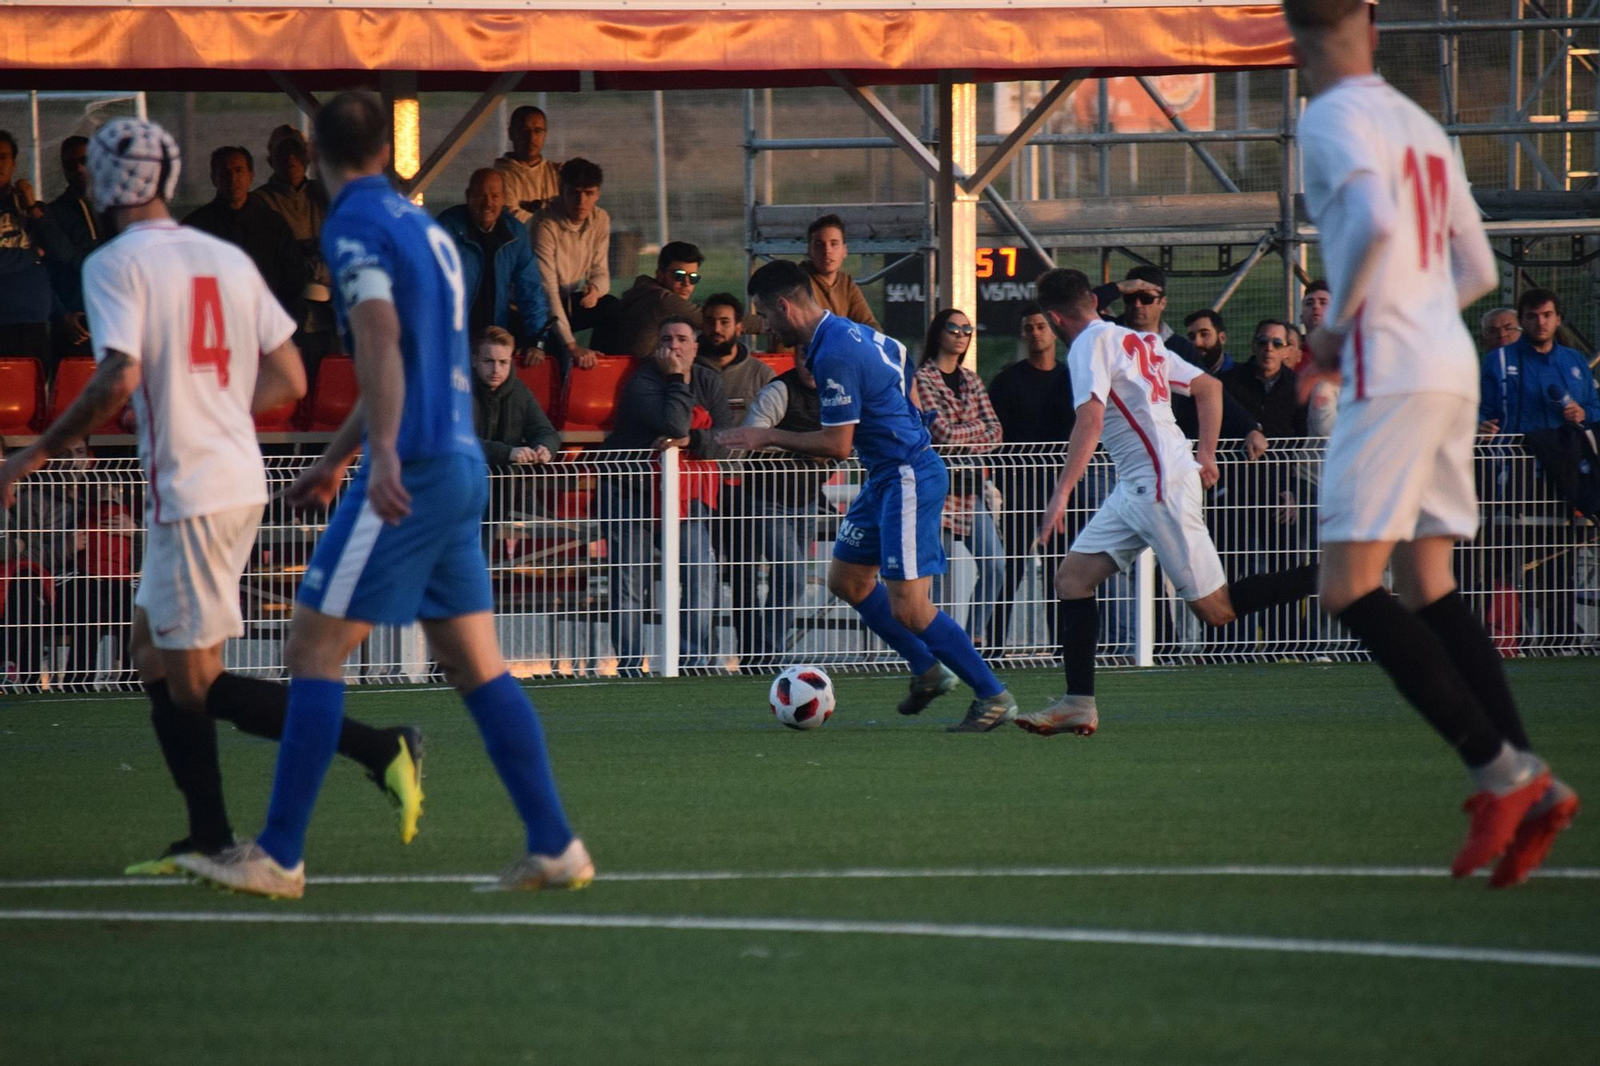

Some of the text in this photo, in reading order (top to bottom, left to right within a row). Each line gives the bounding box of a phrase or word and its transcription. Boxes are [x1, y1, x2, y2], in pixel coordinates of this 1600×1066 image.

[426, 224, 466, 332] 9
[976, 247, 1017, 278] 57
[189, 275, 230, 391] 4
